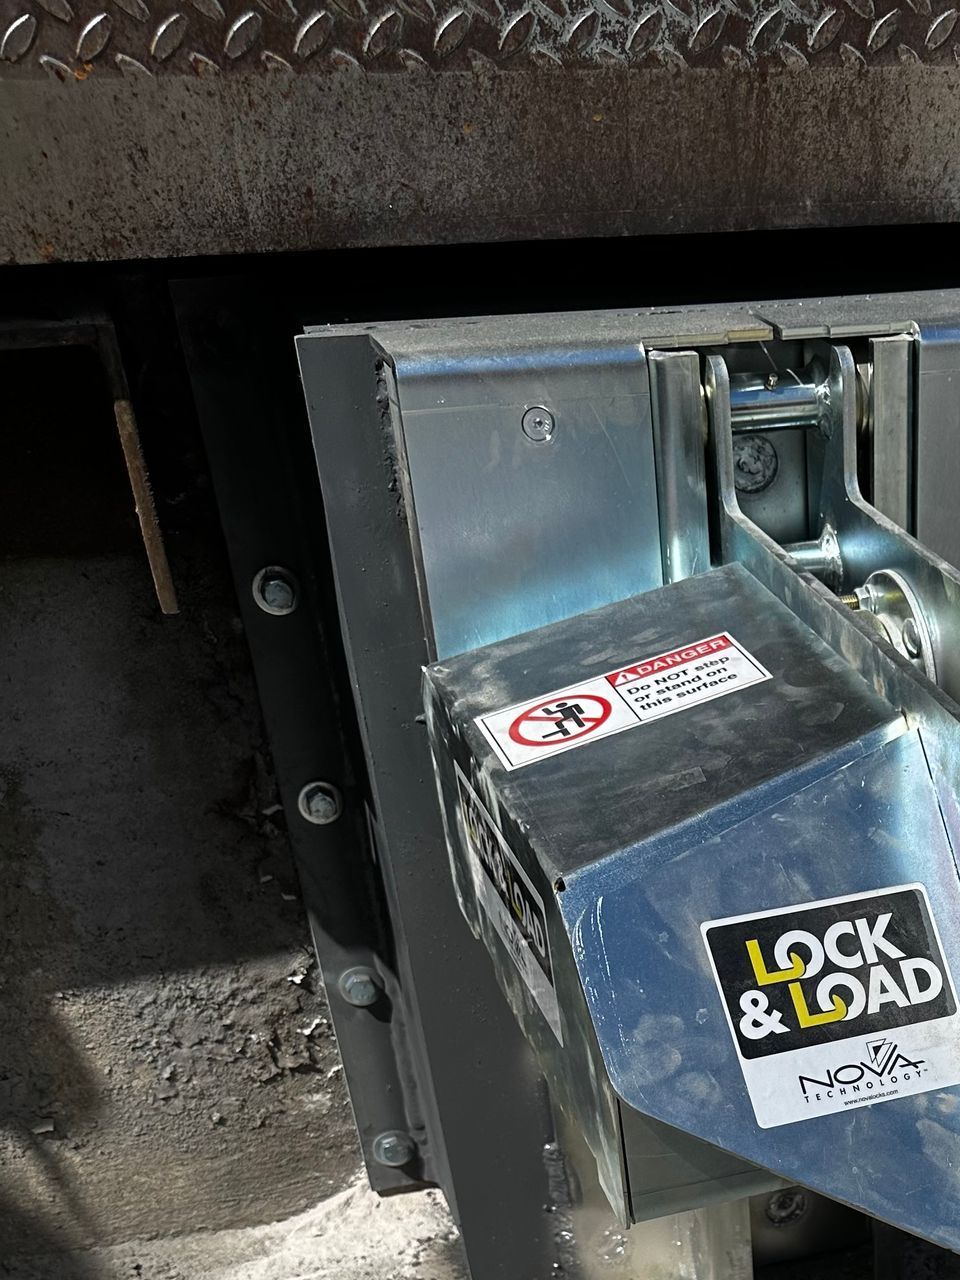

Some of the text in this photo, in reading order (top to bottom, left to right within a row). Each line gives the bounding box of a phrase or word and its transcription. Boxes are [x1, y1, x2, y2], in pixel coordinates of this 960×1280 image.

[627, 656, 730, 695] Do NOT step
[637, 639, 726, 675] DANGER
[634, 667, 728, 703] or stand on
[639, 673, 738, 711] this surface
[745, 912, 907, 987] LOCK
[739, 957, 943, 1040] & LOAD
[799, 1044, 925, 1094] NOVA
